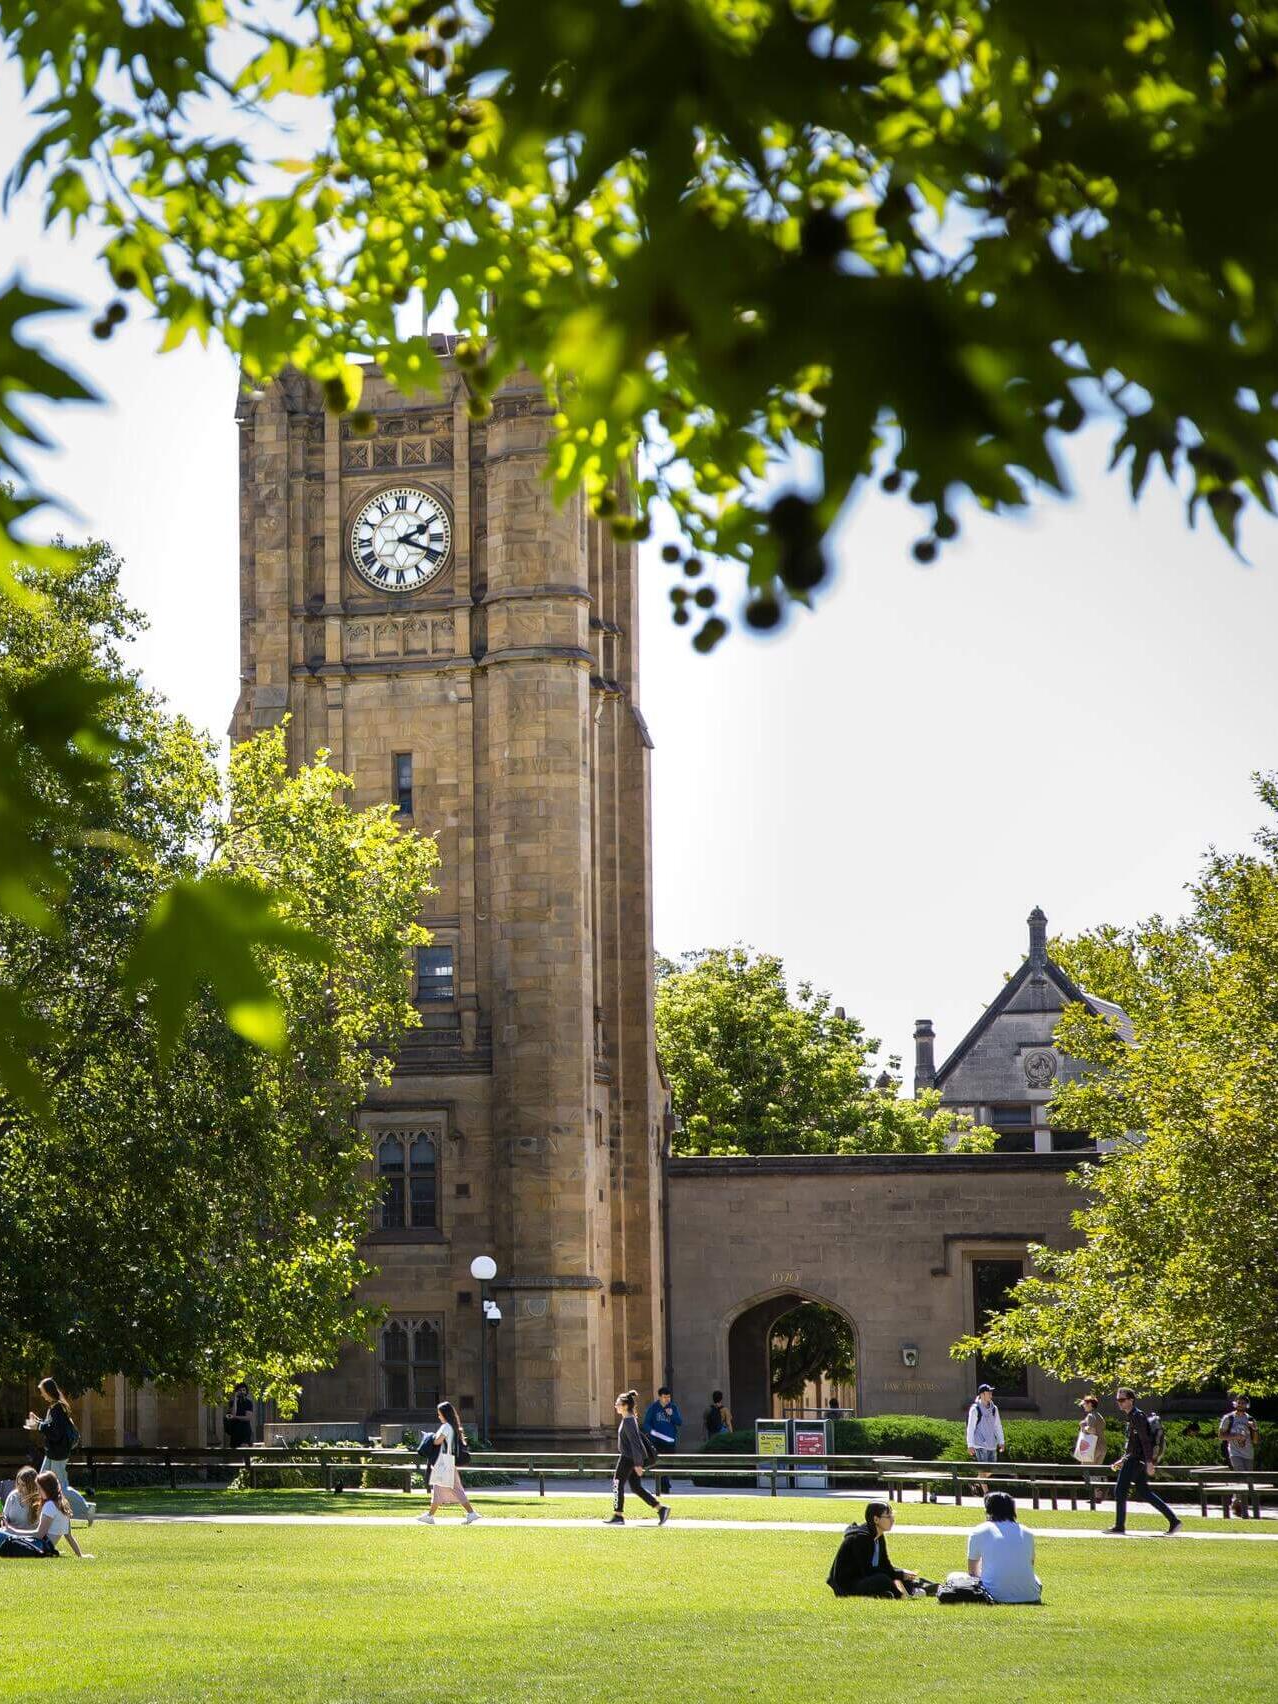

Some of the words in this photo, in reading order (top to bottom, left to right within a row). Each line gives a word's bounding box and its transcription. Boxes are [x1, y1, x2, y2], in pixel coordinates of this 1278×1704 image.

[376, 501, 390, 518] XI
[395, 496, 407, 511] XII
[415, 500, 423, 514] I
[362, 518, 377, 531] X
[425, 513, 439, 525] II
[358, 538, 373, 548] IX
[429, 532, 444, 542] III
[361, 550, 378, 571] VIII
[374, 564, 390, 582] VII
[396, 569, 406, 585] VI
[414, 565, 425, 579] V
